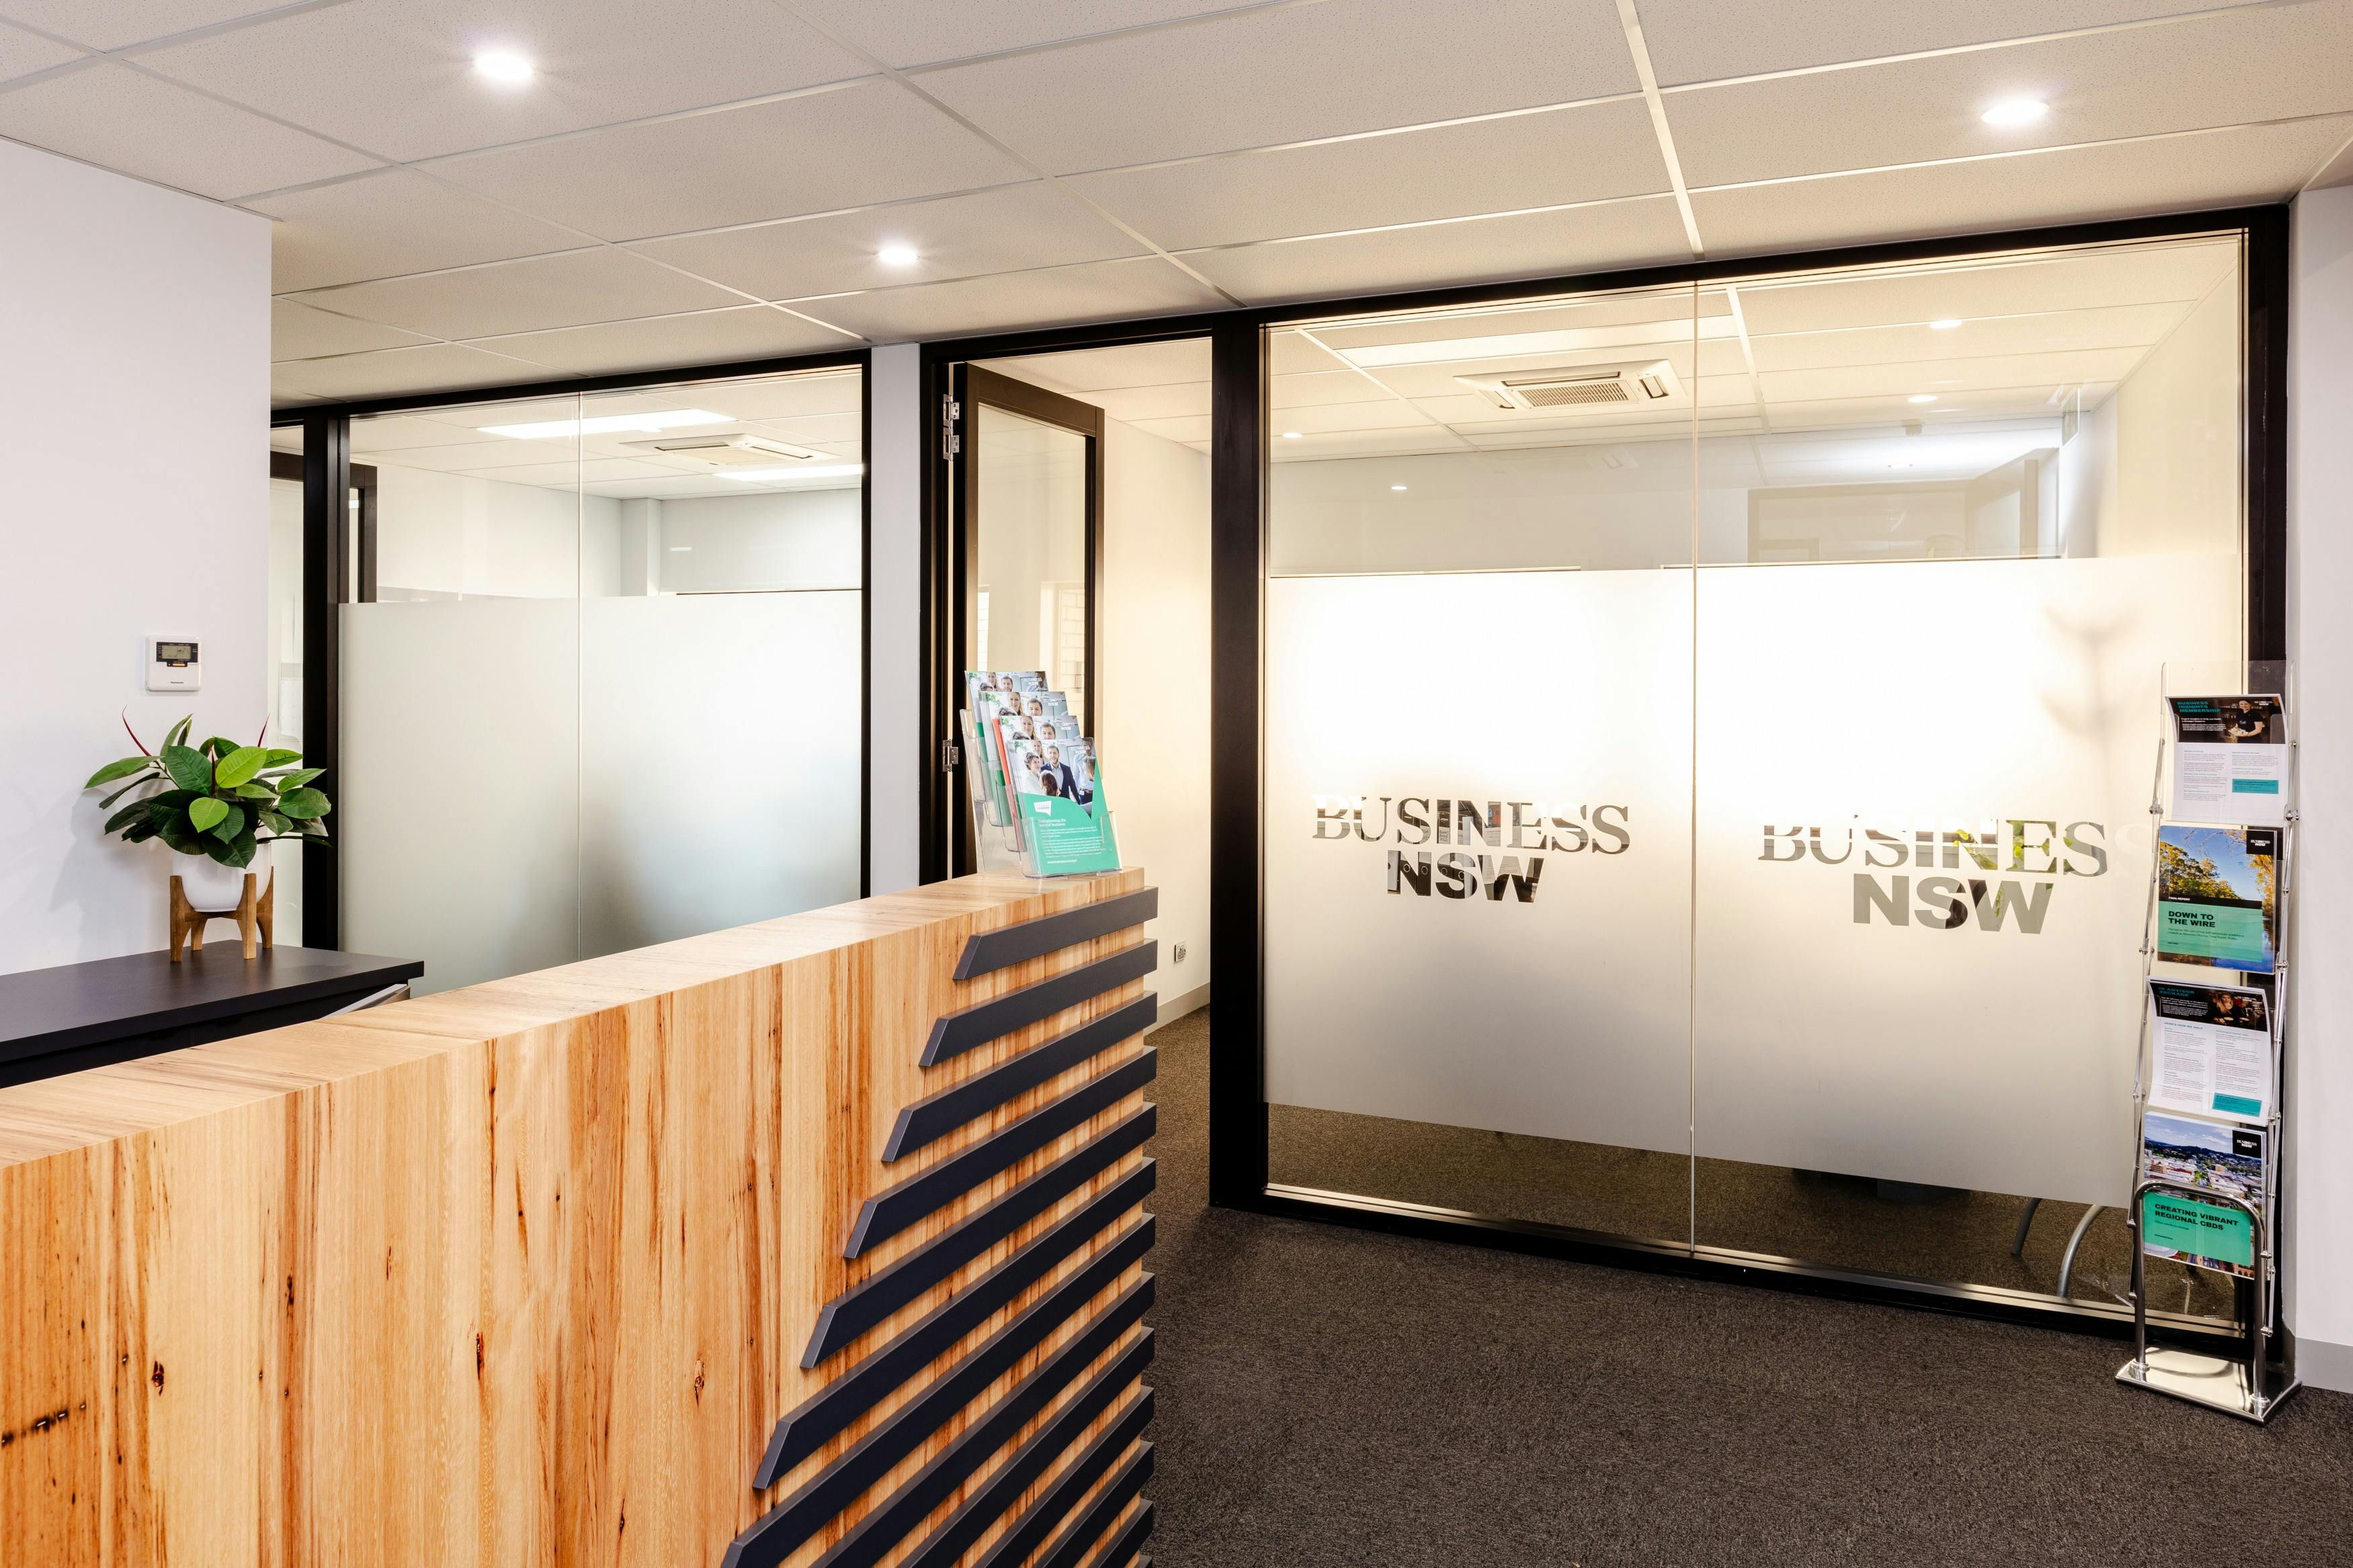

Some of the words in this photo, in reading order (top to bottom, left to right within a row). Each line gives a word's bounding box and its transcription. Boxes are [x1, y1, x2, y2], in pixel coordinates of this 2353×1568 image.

[1312, 794, 1630, 854] BUSINESS
[1387, 850, 1545, 903] NSW
[1853, 873, 2054, 934] NSW
[2155, 1204, 2197, 1217] CREATING
[2200, 1213, 2238, 1226] VIBRANT
[2155, 1210, 2198, 1225] REGIONAL
[2200, 1221, 2224, 1230] CBDS
